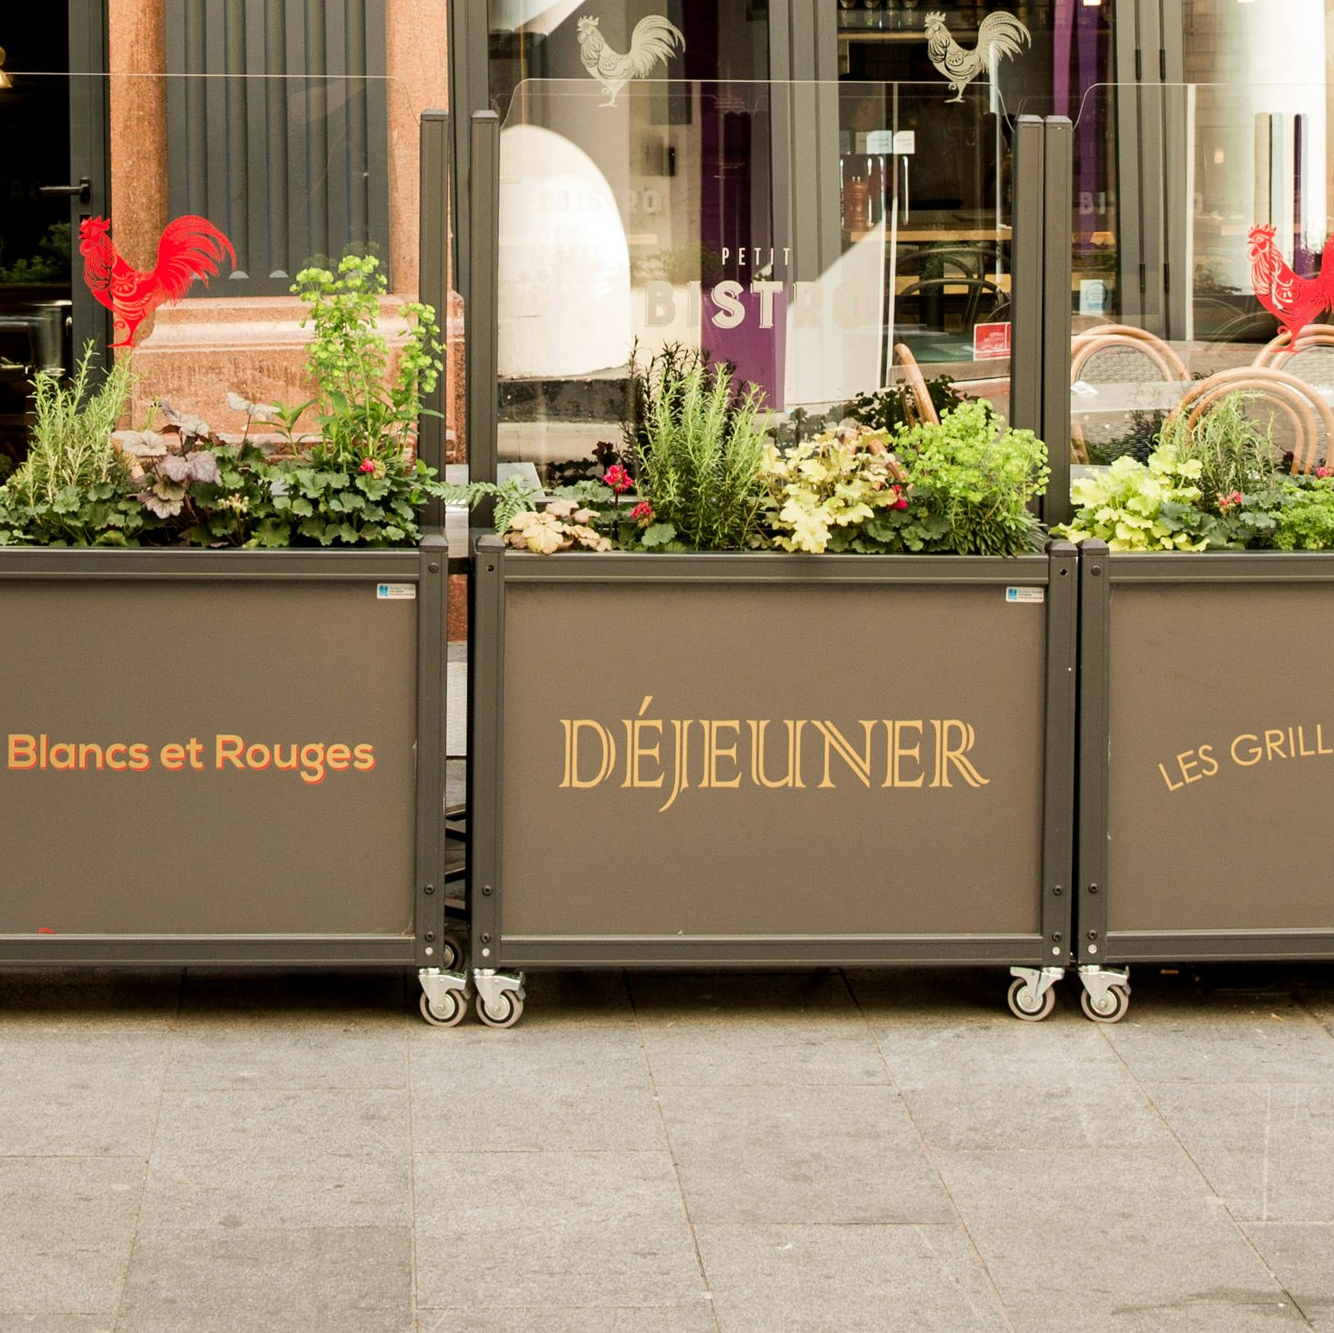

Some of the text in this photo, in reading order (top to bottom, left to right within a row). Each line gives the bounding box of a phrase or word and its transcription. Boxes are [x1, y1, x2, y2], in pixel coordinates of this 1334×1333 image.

[721, 247, 791, 266] PETIT
[644, 279, 868, 330] BISTRO
[7, 733, 151, 772] Blancs
[160, 737, 204, 771] et
[215, 733, 377, 785] Rouges
[559, 695, 990, 812] DÉJEUNER
[1158, 744, 1220, 792] LES
